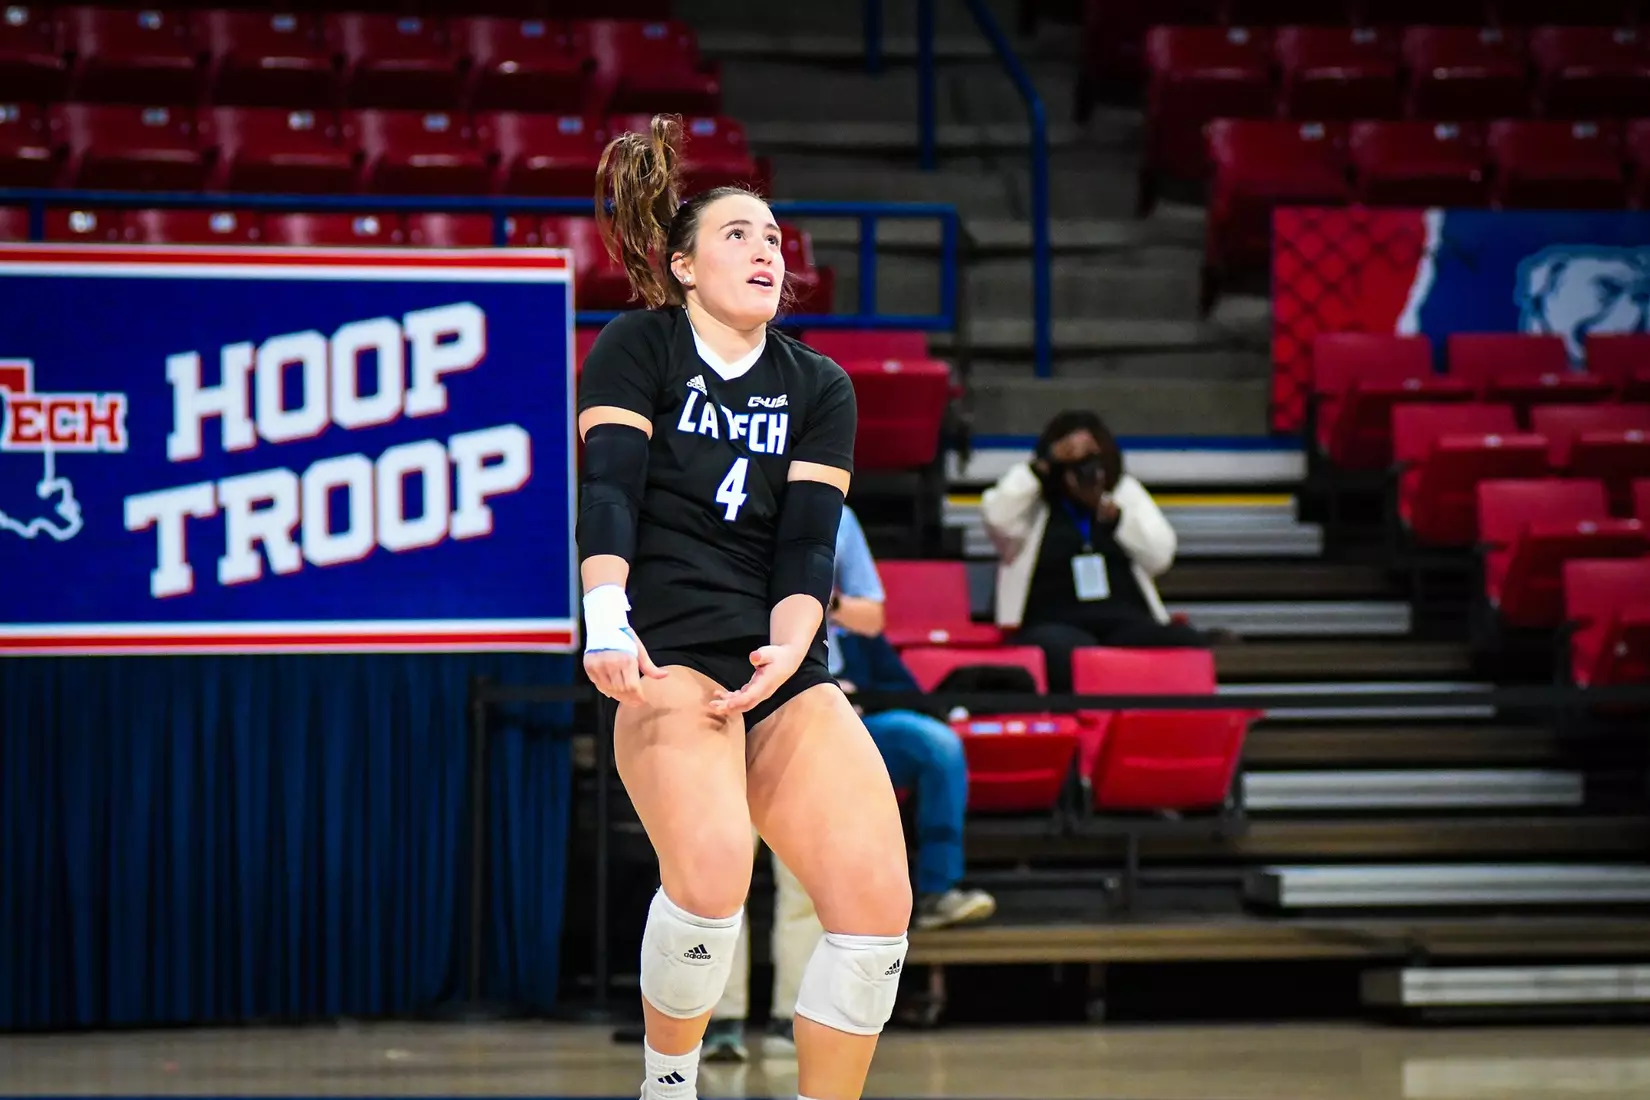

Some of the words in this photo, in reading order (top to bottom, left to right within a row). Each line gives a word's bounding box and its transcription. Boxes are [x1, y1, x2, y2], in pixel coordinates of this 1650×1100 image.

[0, 366, 128, 451] ECH
[166, 302, 486, 462] HOOP
[677, 390, 719, 440] LA
[124, 424, 532, 598] TROOP
[715, 457, 749, 521] 4
